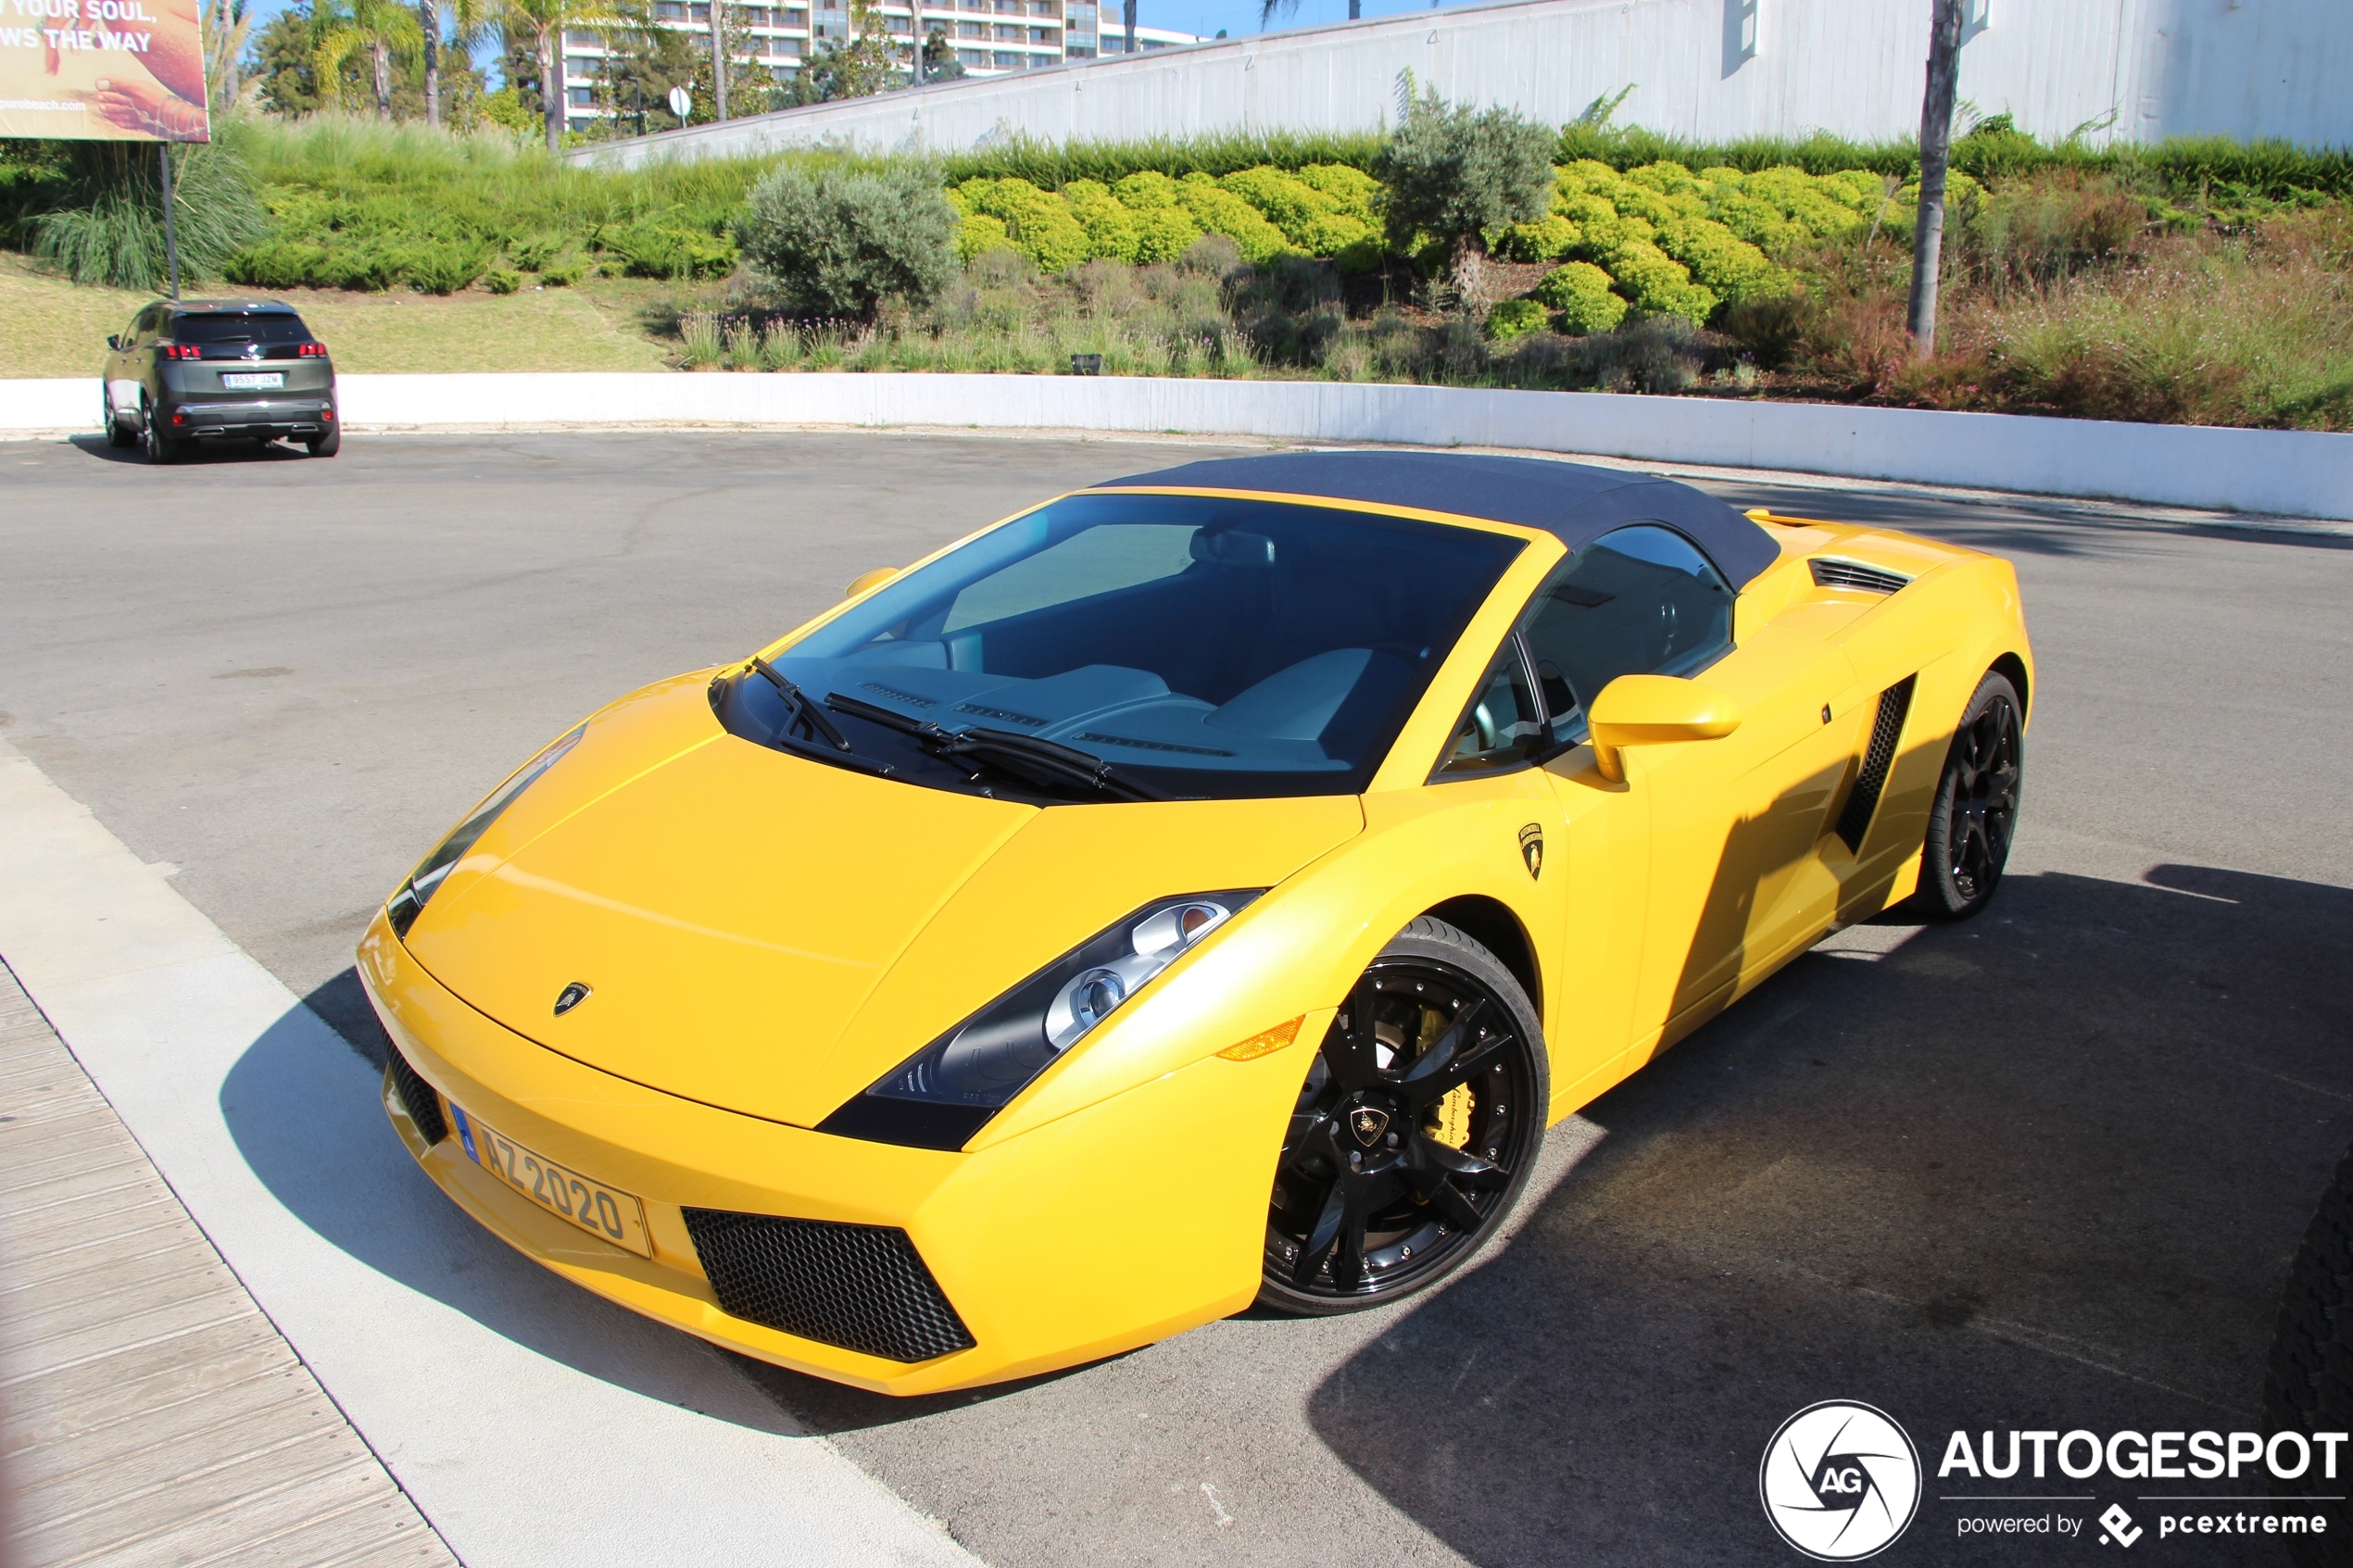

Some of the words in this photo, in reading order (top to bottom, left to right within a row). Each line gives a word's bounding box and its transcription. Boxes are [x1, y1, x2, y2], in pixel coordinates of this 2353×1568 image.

[12, 0, 81, 19] YOUR
[85, 0, 157, 24] SOUL,
[43, 29, 94, 50] THE
[95, 30, 151, 52] WAY
[233, 375, 256, 383] 9557
[523, 1156, 623, 1239] 2020
